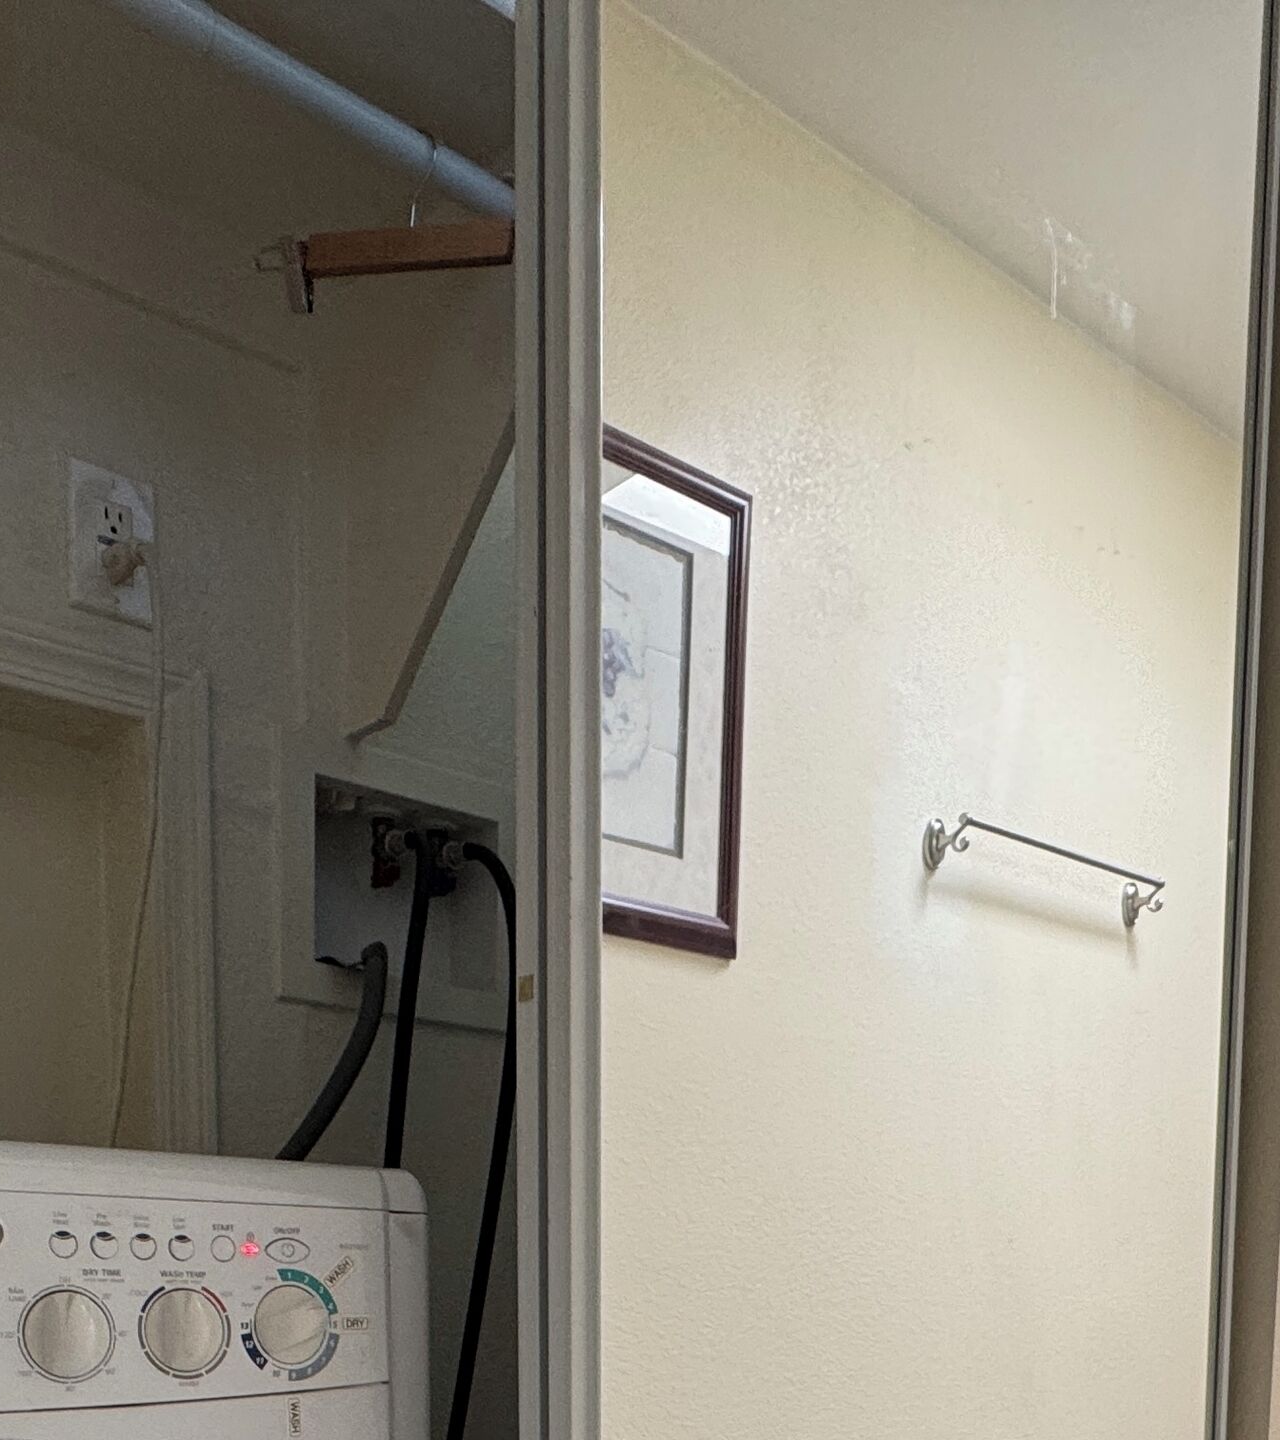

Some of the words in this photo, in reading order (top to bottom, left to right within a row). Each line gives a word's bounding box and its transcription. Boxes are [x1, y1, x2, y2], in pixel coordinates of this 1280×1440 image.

[327, 1260, 351, 1286] WASH
[346, 1319, 365, 1328] DRY
[290, 1401, 300, 1434] WASH
